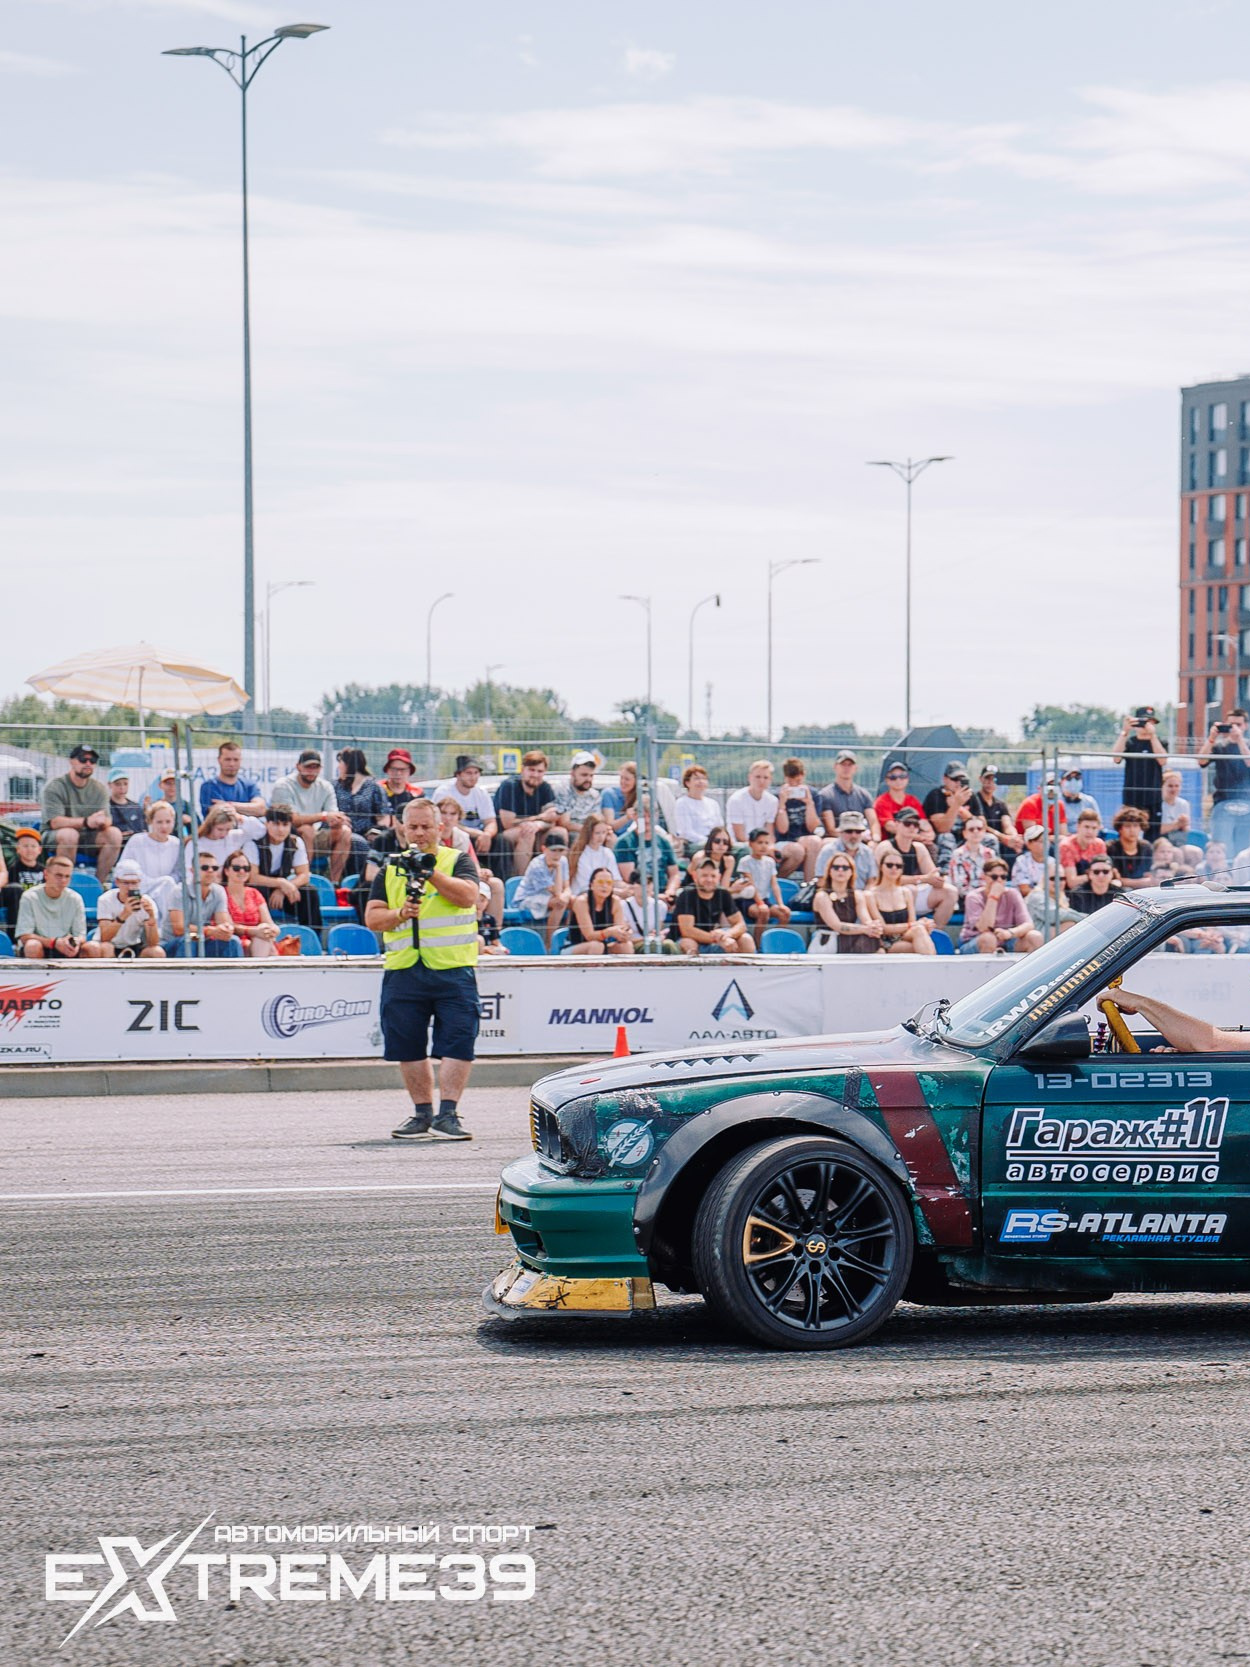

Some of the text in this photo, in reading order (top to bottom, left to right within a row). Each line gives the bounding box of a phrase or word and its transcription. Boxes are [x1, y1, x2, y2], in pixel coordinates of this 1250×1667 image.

[0, 999, 62, 1010] АВТО
[985, 984, 1050, 1038] RWD
[126, 999, 201, 1031] ZIC
[548, 1007, 654, 1025] MANNOL
[478, 1029, 506, 1038] ILTER
[1034, 1071, 1213, 1089] 13-02313
[1006, 1163, 1220, 1185] автосервис
[1006, 1213, 1228, 1234] RS-ATLANTA
[1101, 1234, 1219, 1243] РЕКЛАМНАЯ СТУДИЯ
